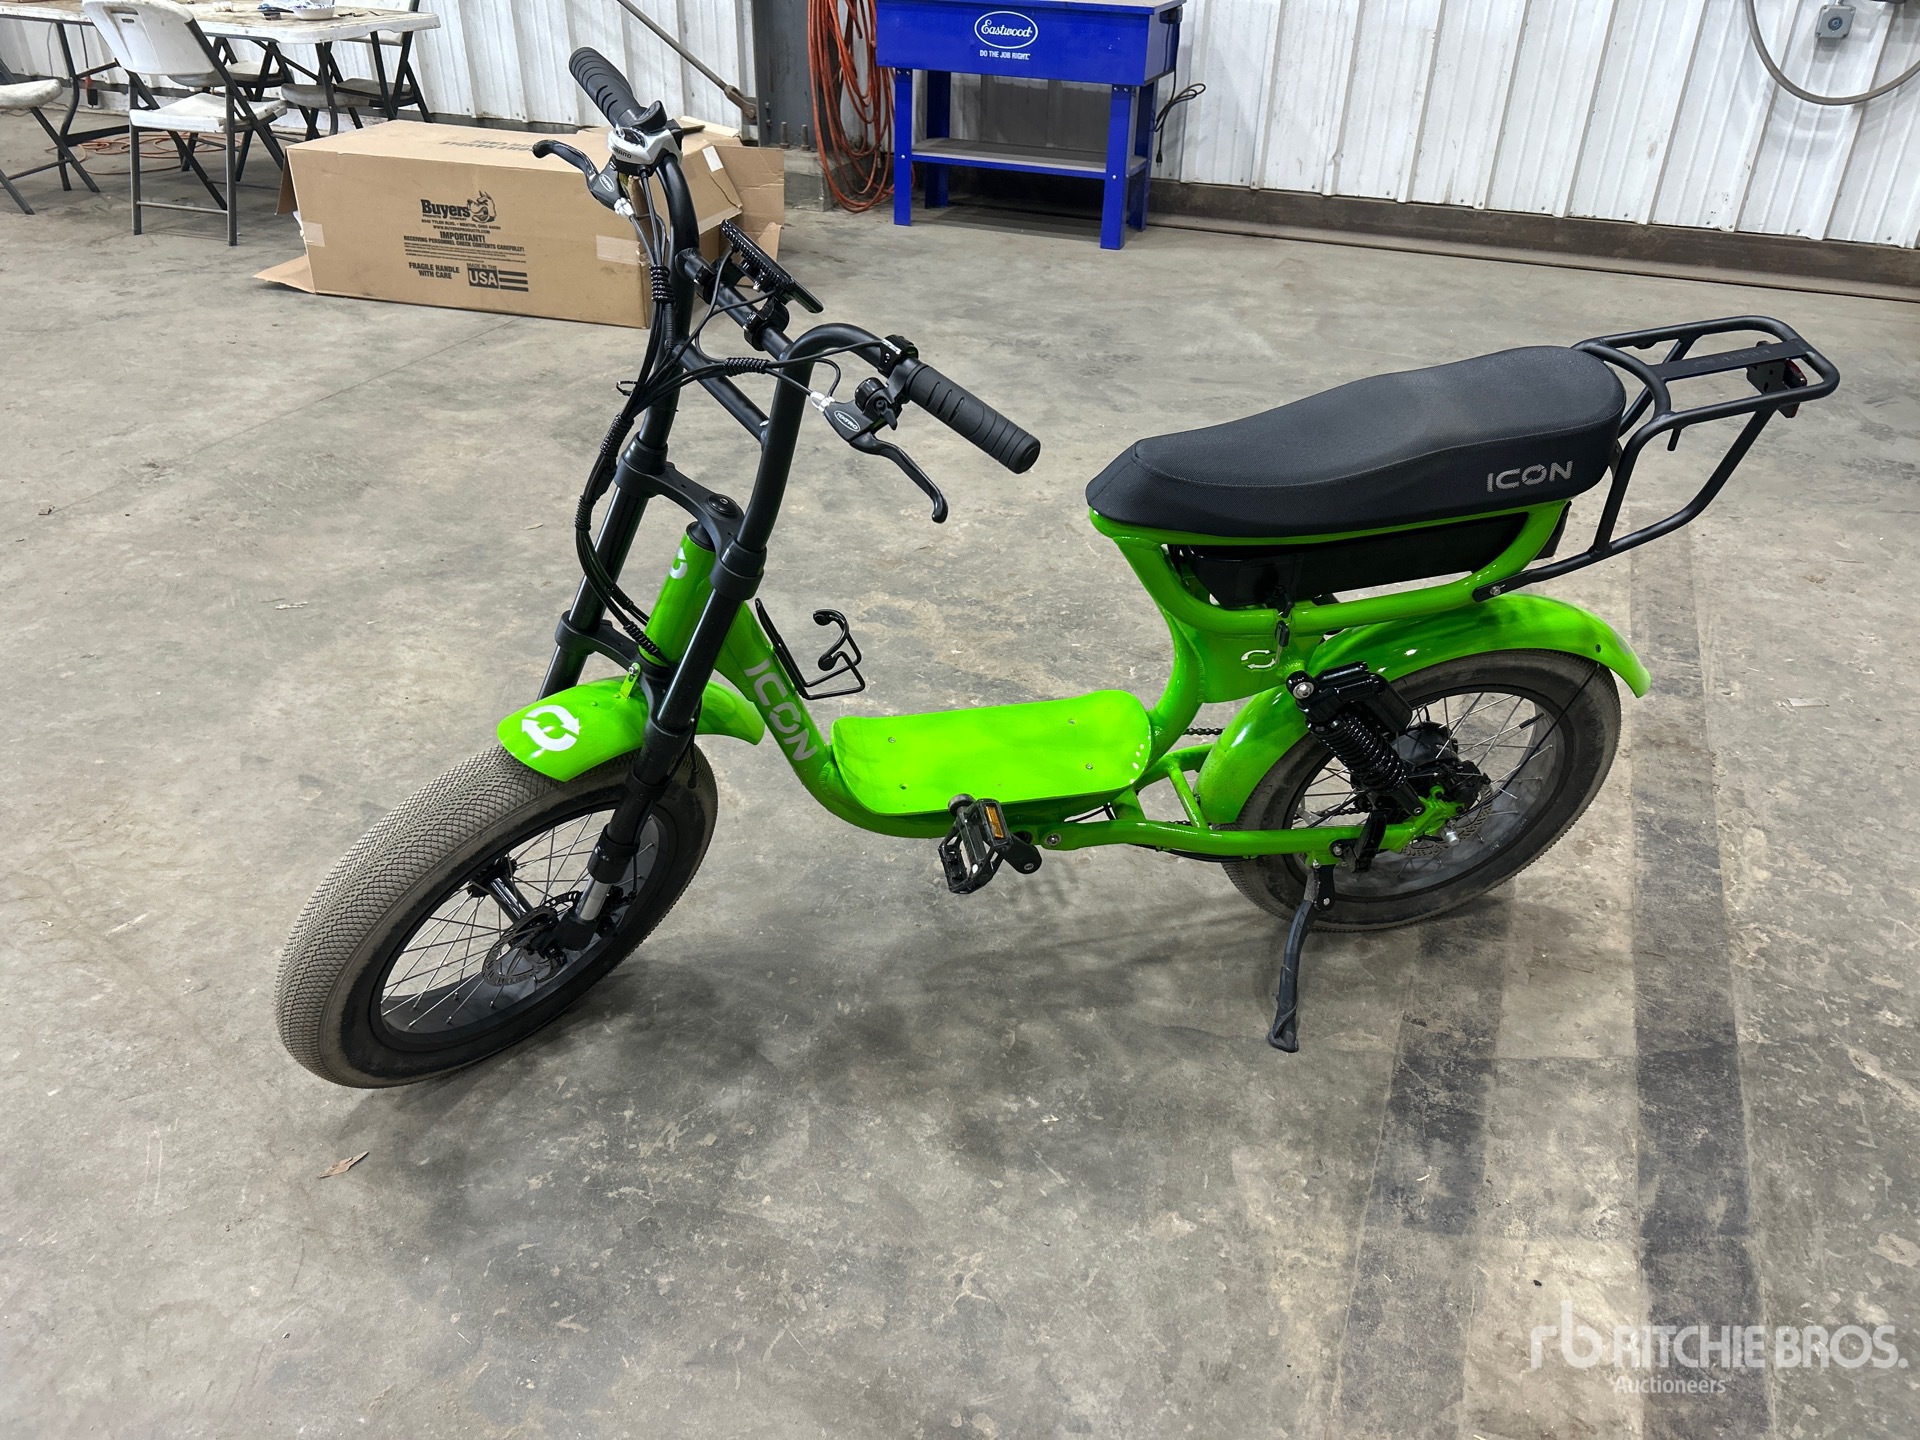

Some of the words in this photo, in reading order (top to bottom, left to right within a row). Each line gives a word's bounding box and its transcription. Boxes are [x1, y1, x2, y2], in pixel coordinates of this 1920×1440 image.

[980, 19, 1033, 37] Eastwood
[979, 49, 989, 57] DO
[989, 50, 1000, 58] THE
[1000, 51, 1011, 59] JOB
[420, 199, 471, 219] Buyers
[404, 235, 428, 243] RECEIVING
[428, 237, 455, 246] PERSONNEL
[472, 242, 496, 250] CONTENTS
[440, 231, 486, 242] IMPORTANT!
[409, 262, 434, 271] FRAGILE
[435, 264, 460, 274] HANDLE
[418, 270, 434, 278] WITH
[435, 271, 452, 279] CARE
[469, 270, 498, 286] USA
[836, 412, 858, 430] TEKTRO
[1486, 460, 1573, 493] ICON
[743, 658, 819, 762] ICON
